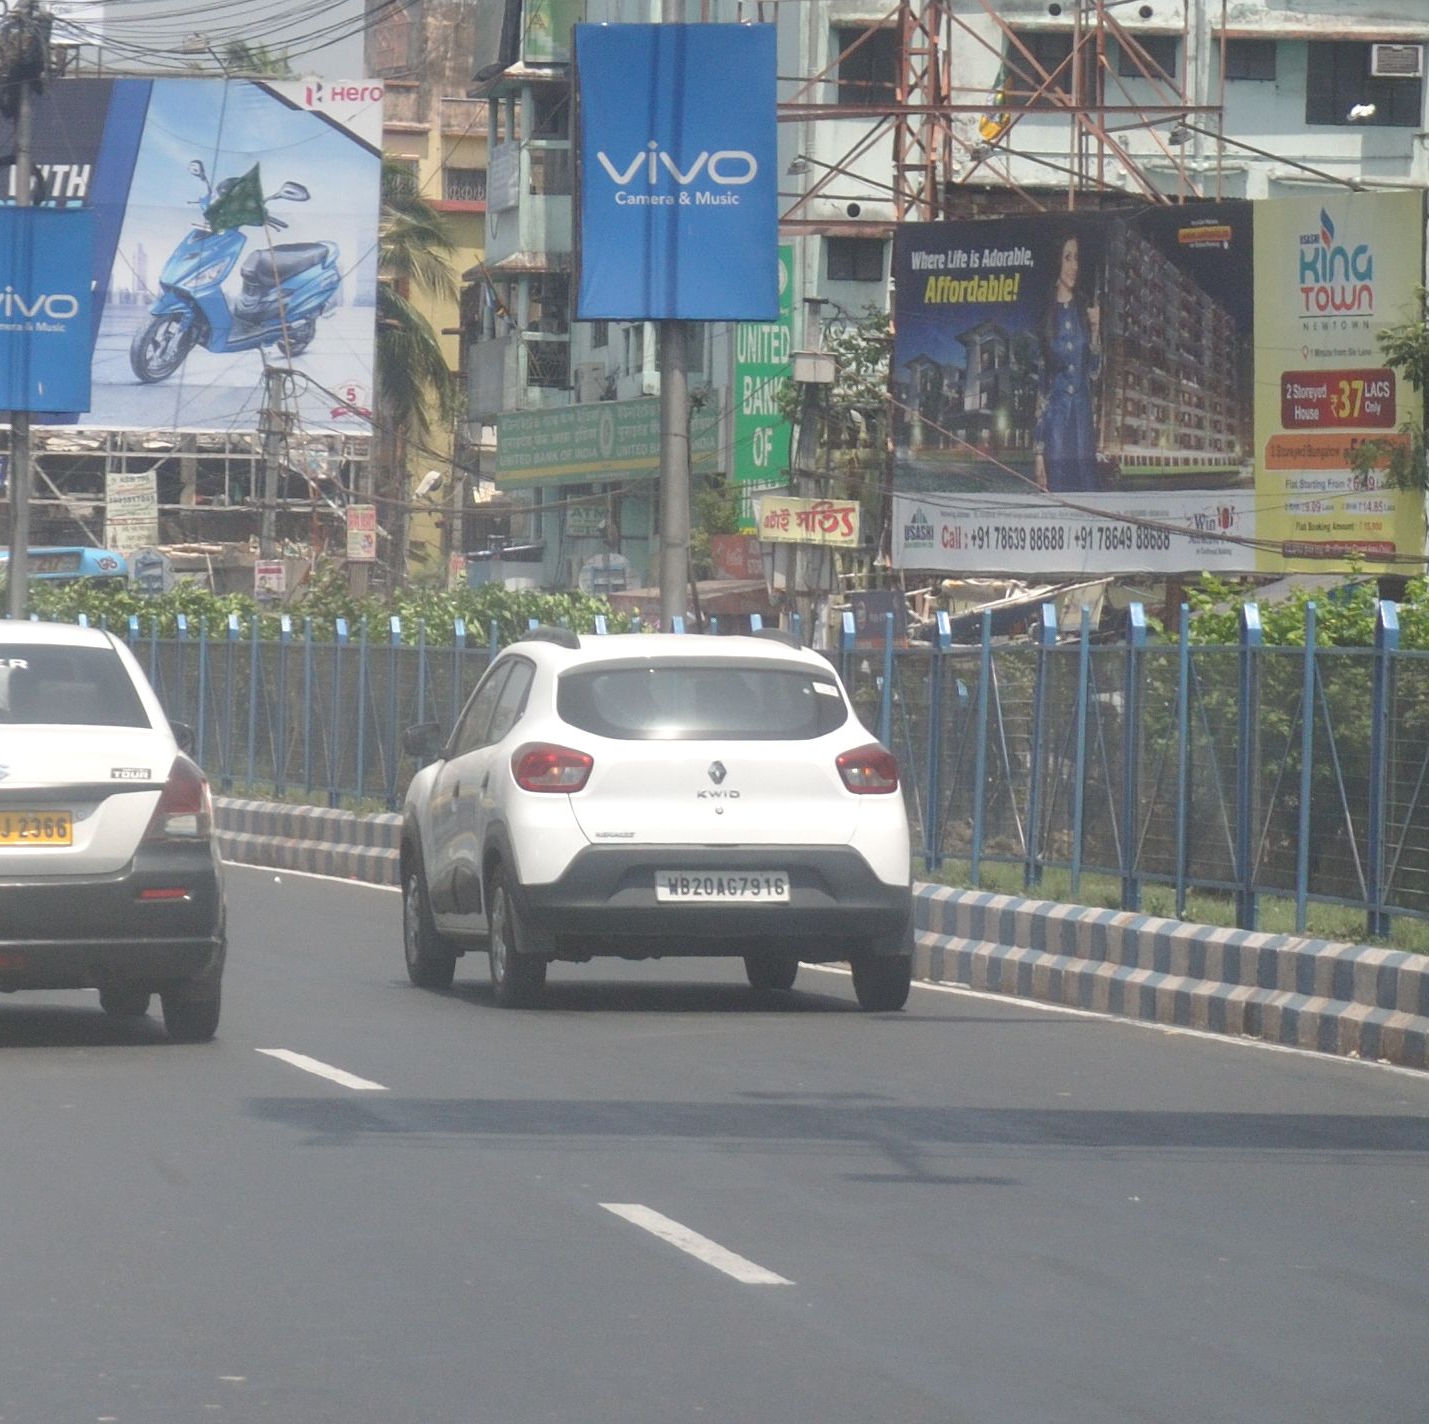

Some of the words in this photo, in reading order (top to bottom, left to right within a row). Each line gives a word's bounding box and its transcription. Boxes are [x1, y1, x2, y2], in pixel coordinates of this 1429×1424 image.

[597, 140, 758, 185] vivo
[615, 191, 675, 205] Camera
[679, 192, 691, 205] &
[696, 191, 740, 205] Music
[911, 250, 945, 270] Where
[947, 248, 968, 269] Life
[970, 249, 980, 268] is
[982, 247, 1034, 268] Adorable,
[924, 273, 1021, 304] Affordable!
[36, 322, 66, 332] Music
[736, 325, 790, 365] UNITED
[1293, 384, 1327, 402] Storeyed
[1364, 382, 1390, 398] LACS
[1295, 406, 1320, 420] House
[1364, 402, 1381, 416] Only
[616, 444, 647, 457] UNITED
[752, 427, 773, 466] OF
[500, 454, 532, 466] UNITED
[533, 452, 558, 464] BANK
[559, 451, 572, 463] OF
[574, 447, 598, 460] INDIA
[904, 528, 934, 541] USASHI
[941, 525, 962, 550] Call
[971, 526, 990, 550] +91
[994, 525, 1026, 550] 78639
[1030, 526, 1064, 550] 88688
[1074, 526, 1093, 550] +91
[1098, 526, 1132, 550] 78649
[1136, 527, 1171, 551] 88688
[112, 771, 151, 779] TOUR
[696, 790, 741, 799] KWID
